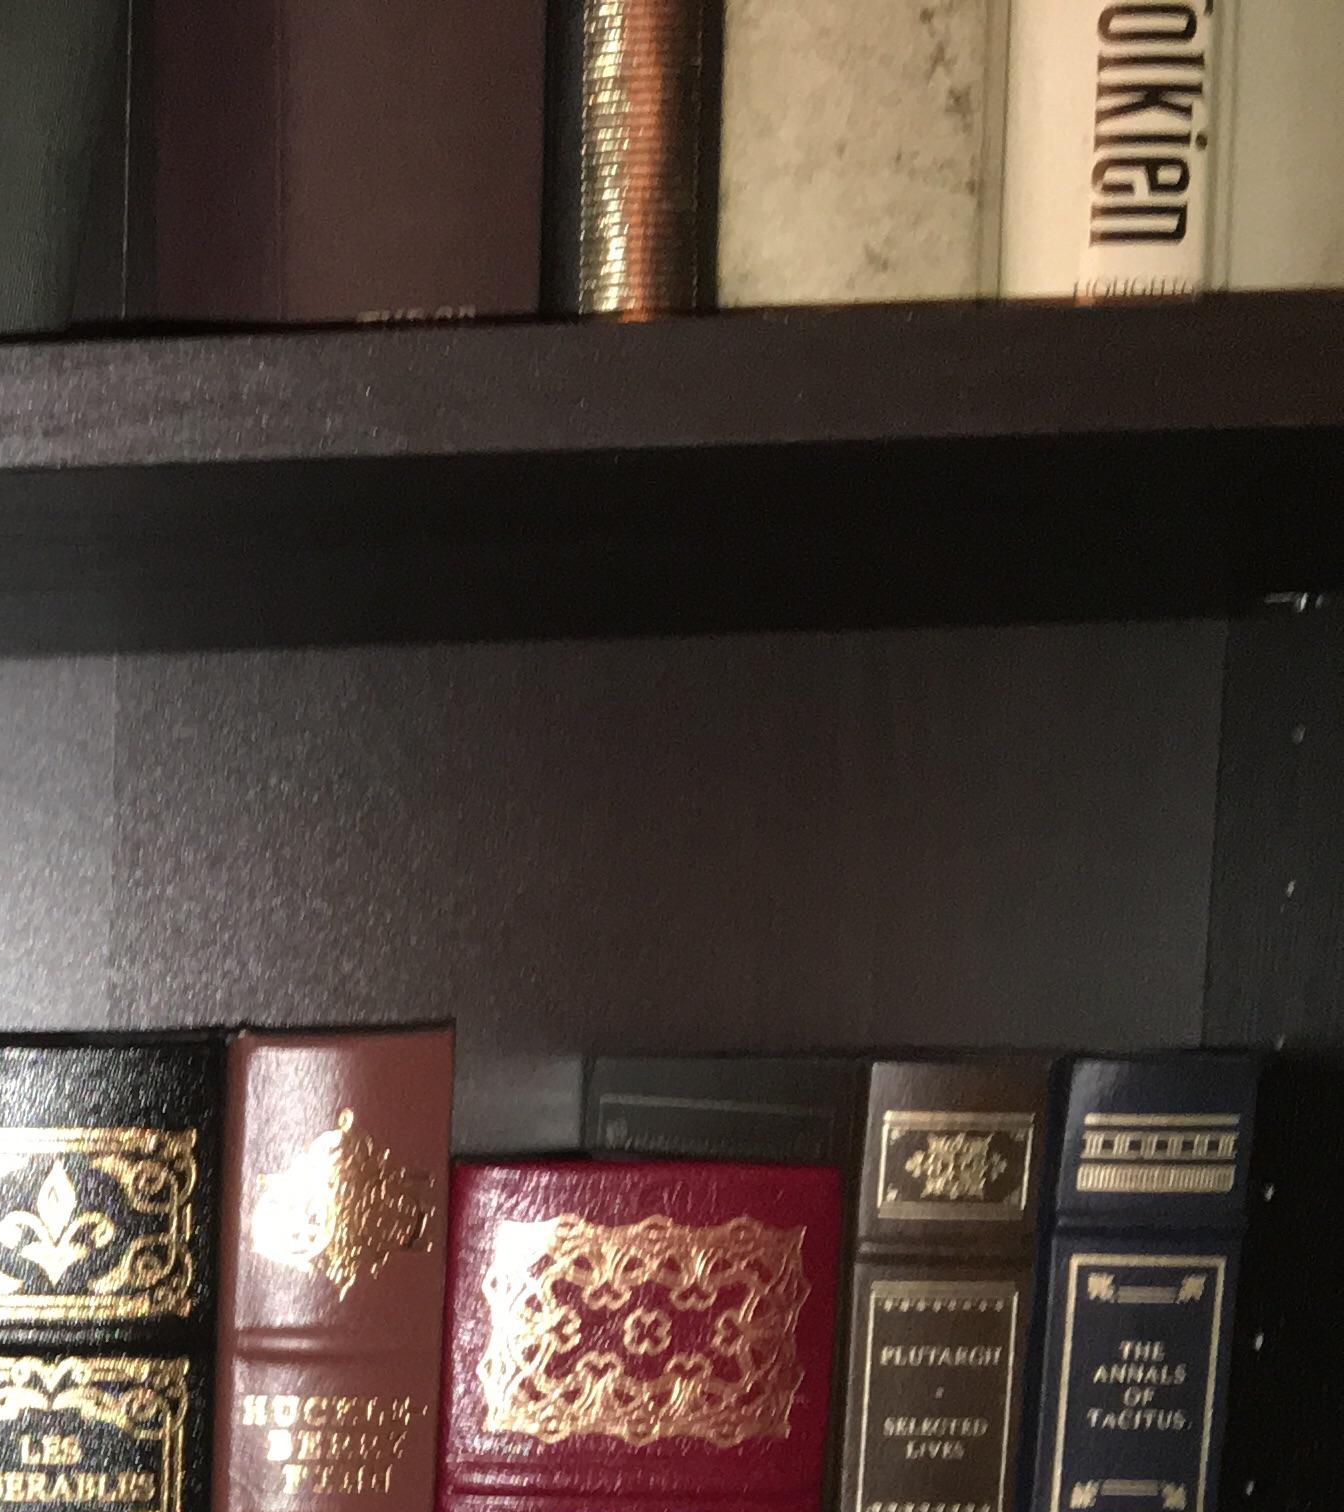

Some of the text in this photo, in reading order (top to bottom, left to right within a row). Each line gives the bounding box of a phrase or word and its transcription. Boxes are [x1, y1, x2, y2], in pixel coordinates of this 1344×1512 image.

[1089, 0, 1215, 247] olkien
[1120, 1340, 1165, 1362] THE
[1092, 1363, 1188, 1386] ANNALS
[1123, 1386, 1156, 1408] OF
